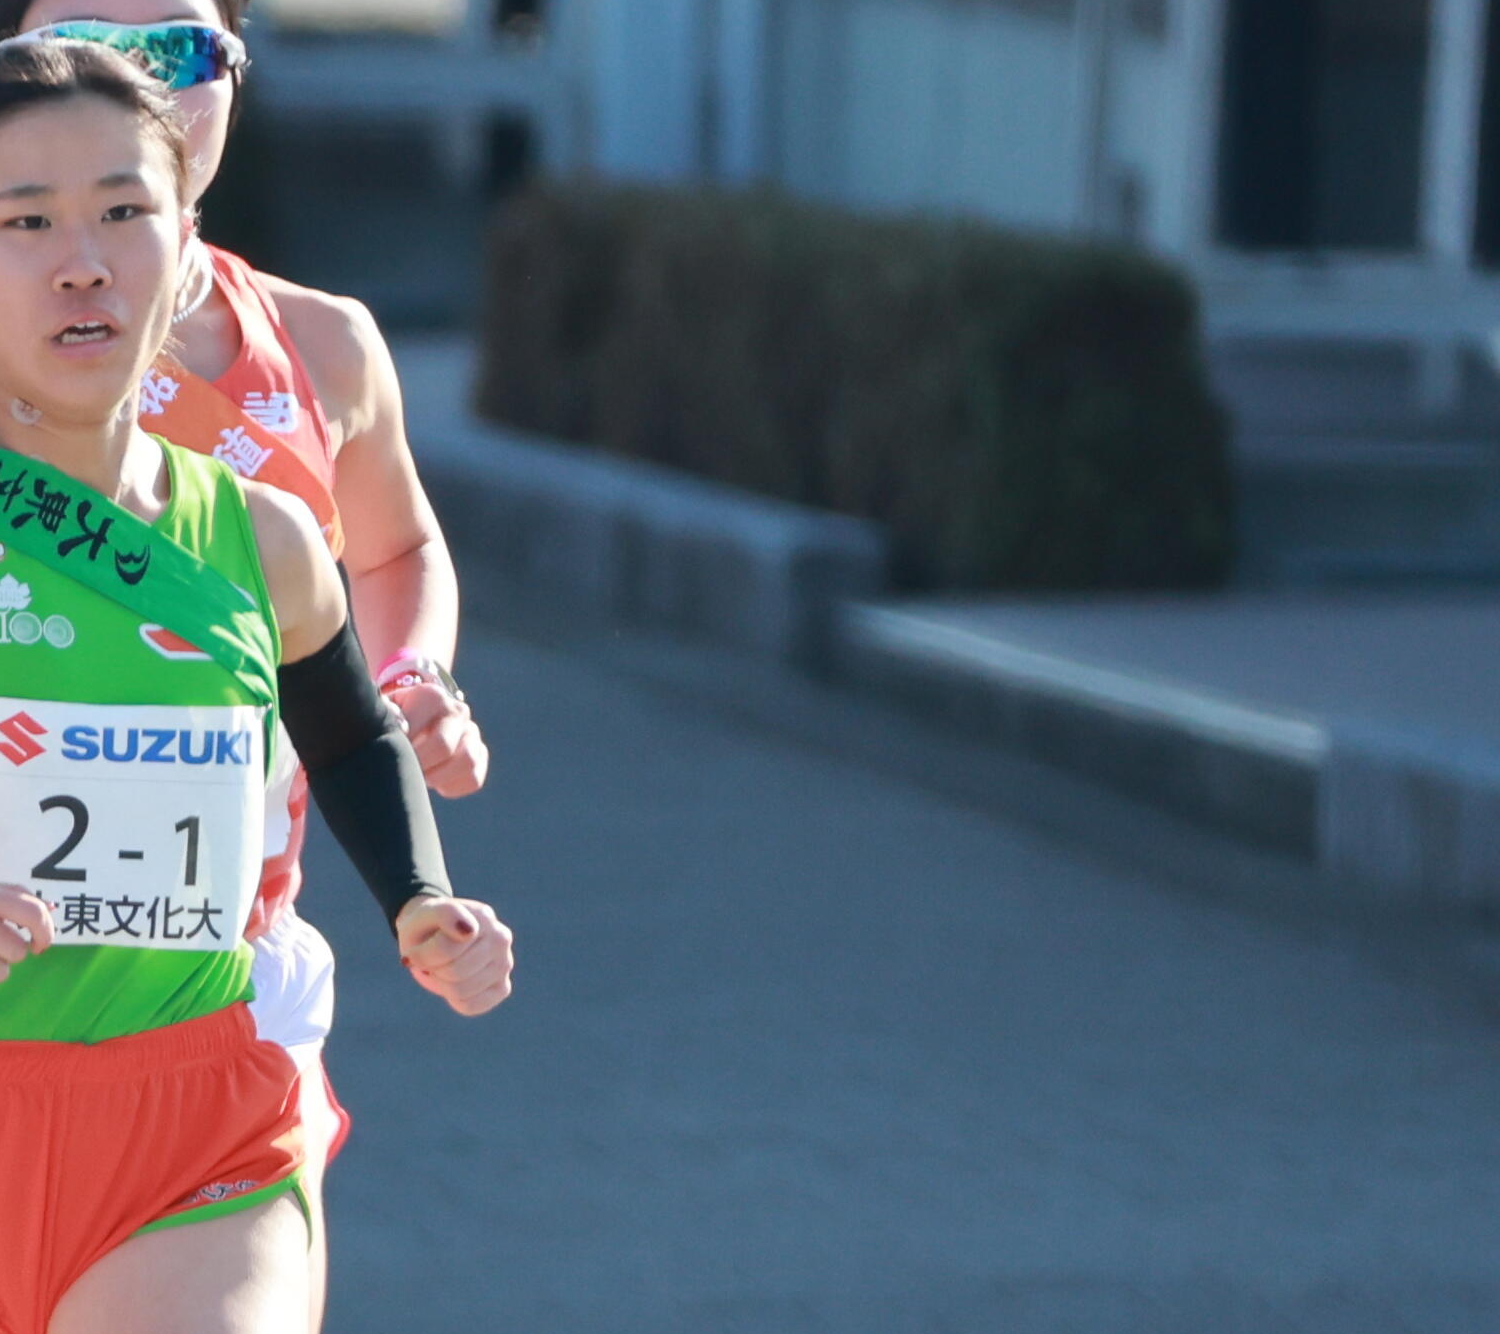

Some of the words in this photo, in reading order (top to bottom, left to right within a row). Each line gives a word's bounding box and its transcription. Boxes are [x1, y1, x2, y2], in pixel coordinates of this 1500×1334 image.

[61, 726, 252, 766] SUZUKI
[30, 794, 201, 886] 2-1
[36, 891, 223, 941] 東文化大
